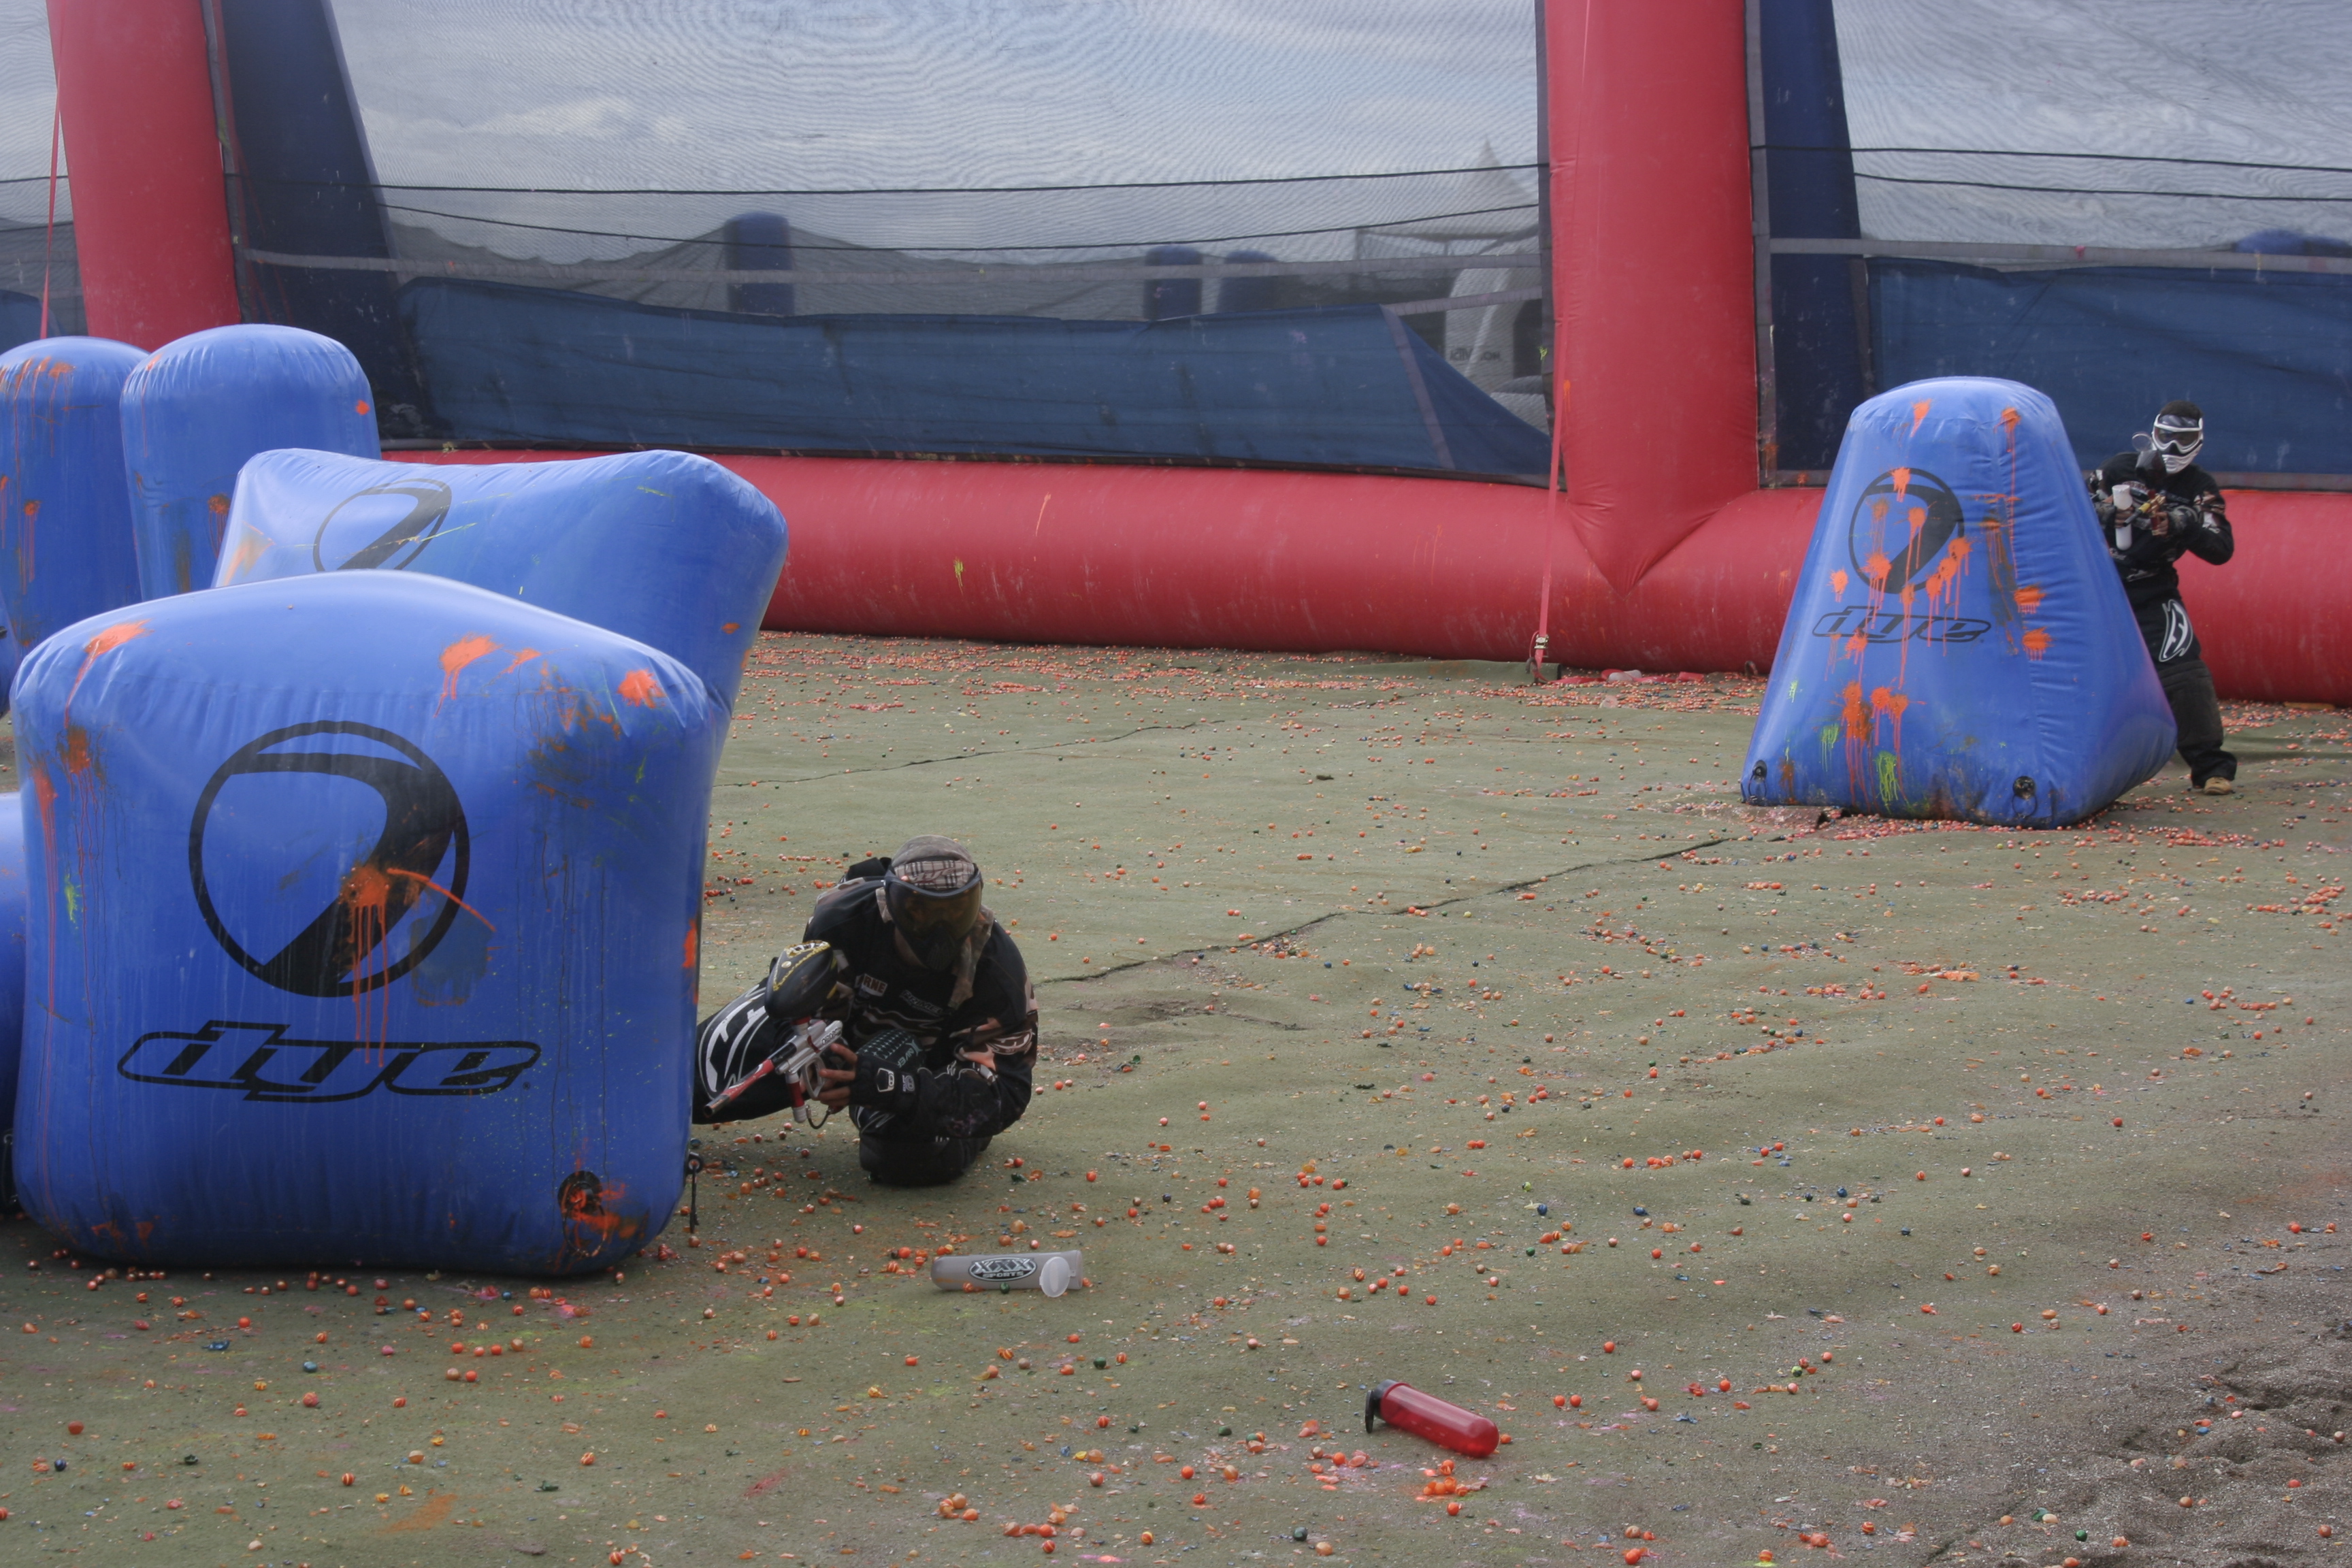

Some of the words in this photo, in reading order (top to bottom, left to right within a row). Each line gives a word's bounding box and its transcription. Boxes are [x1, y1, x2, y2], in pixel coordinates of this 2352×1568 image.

[1812, 605, 1991, 643] dye
[117, 1019, 541, 1102] dye
[972, 1258, 1033, 1273] XXX
